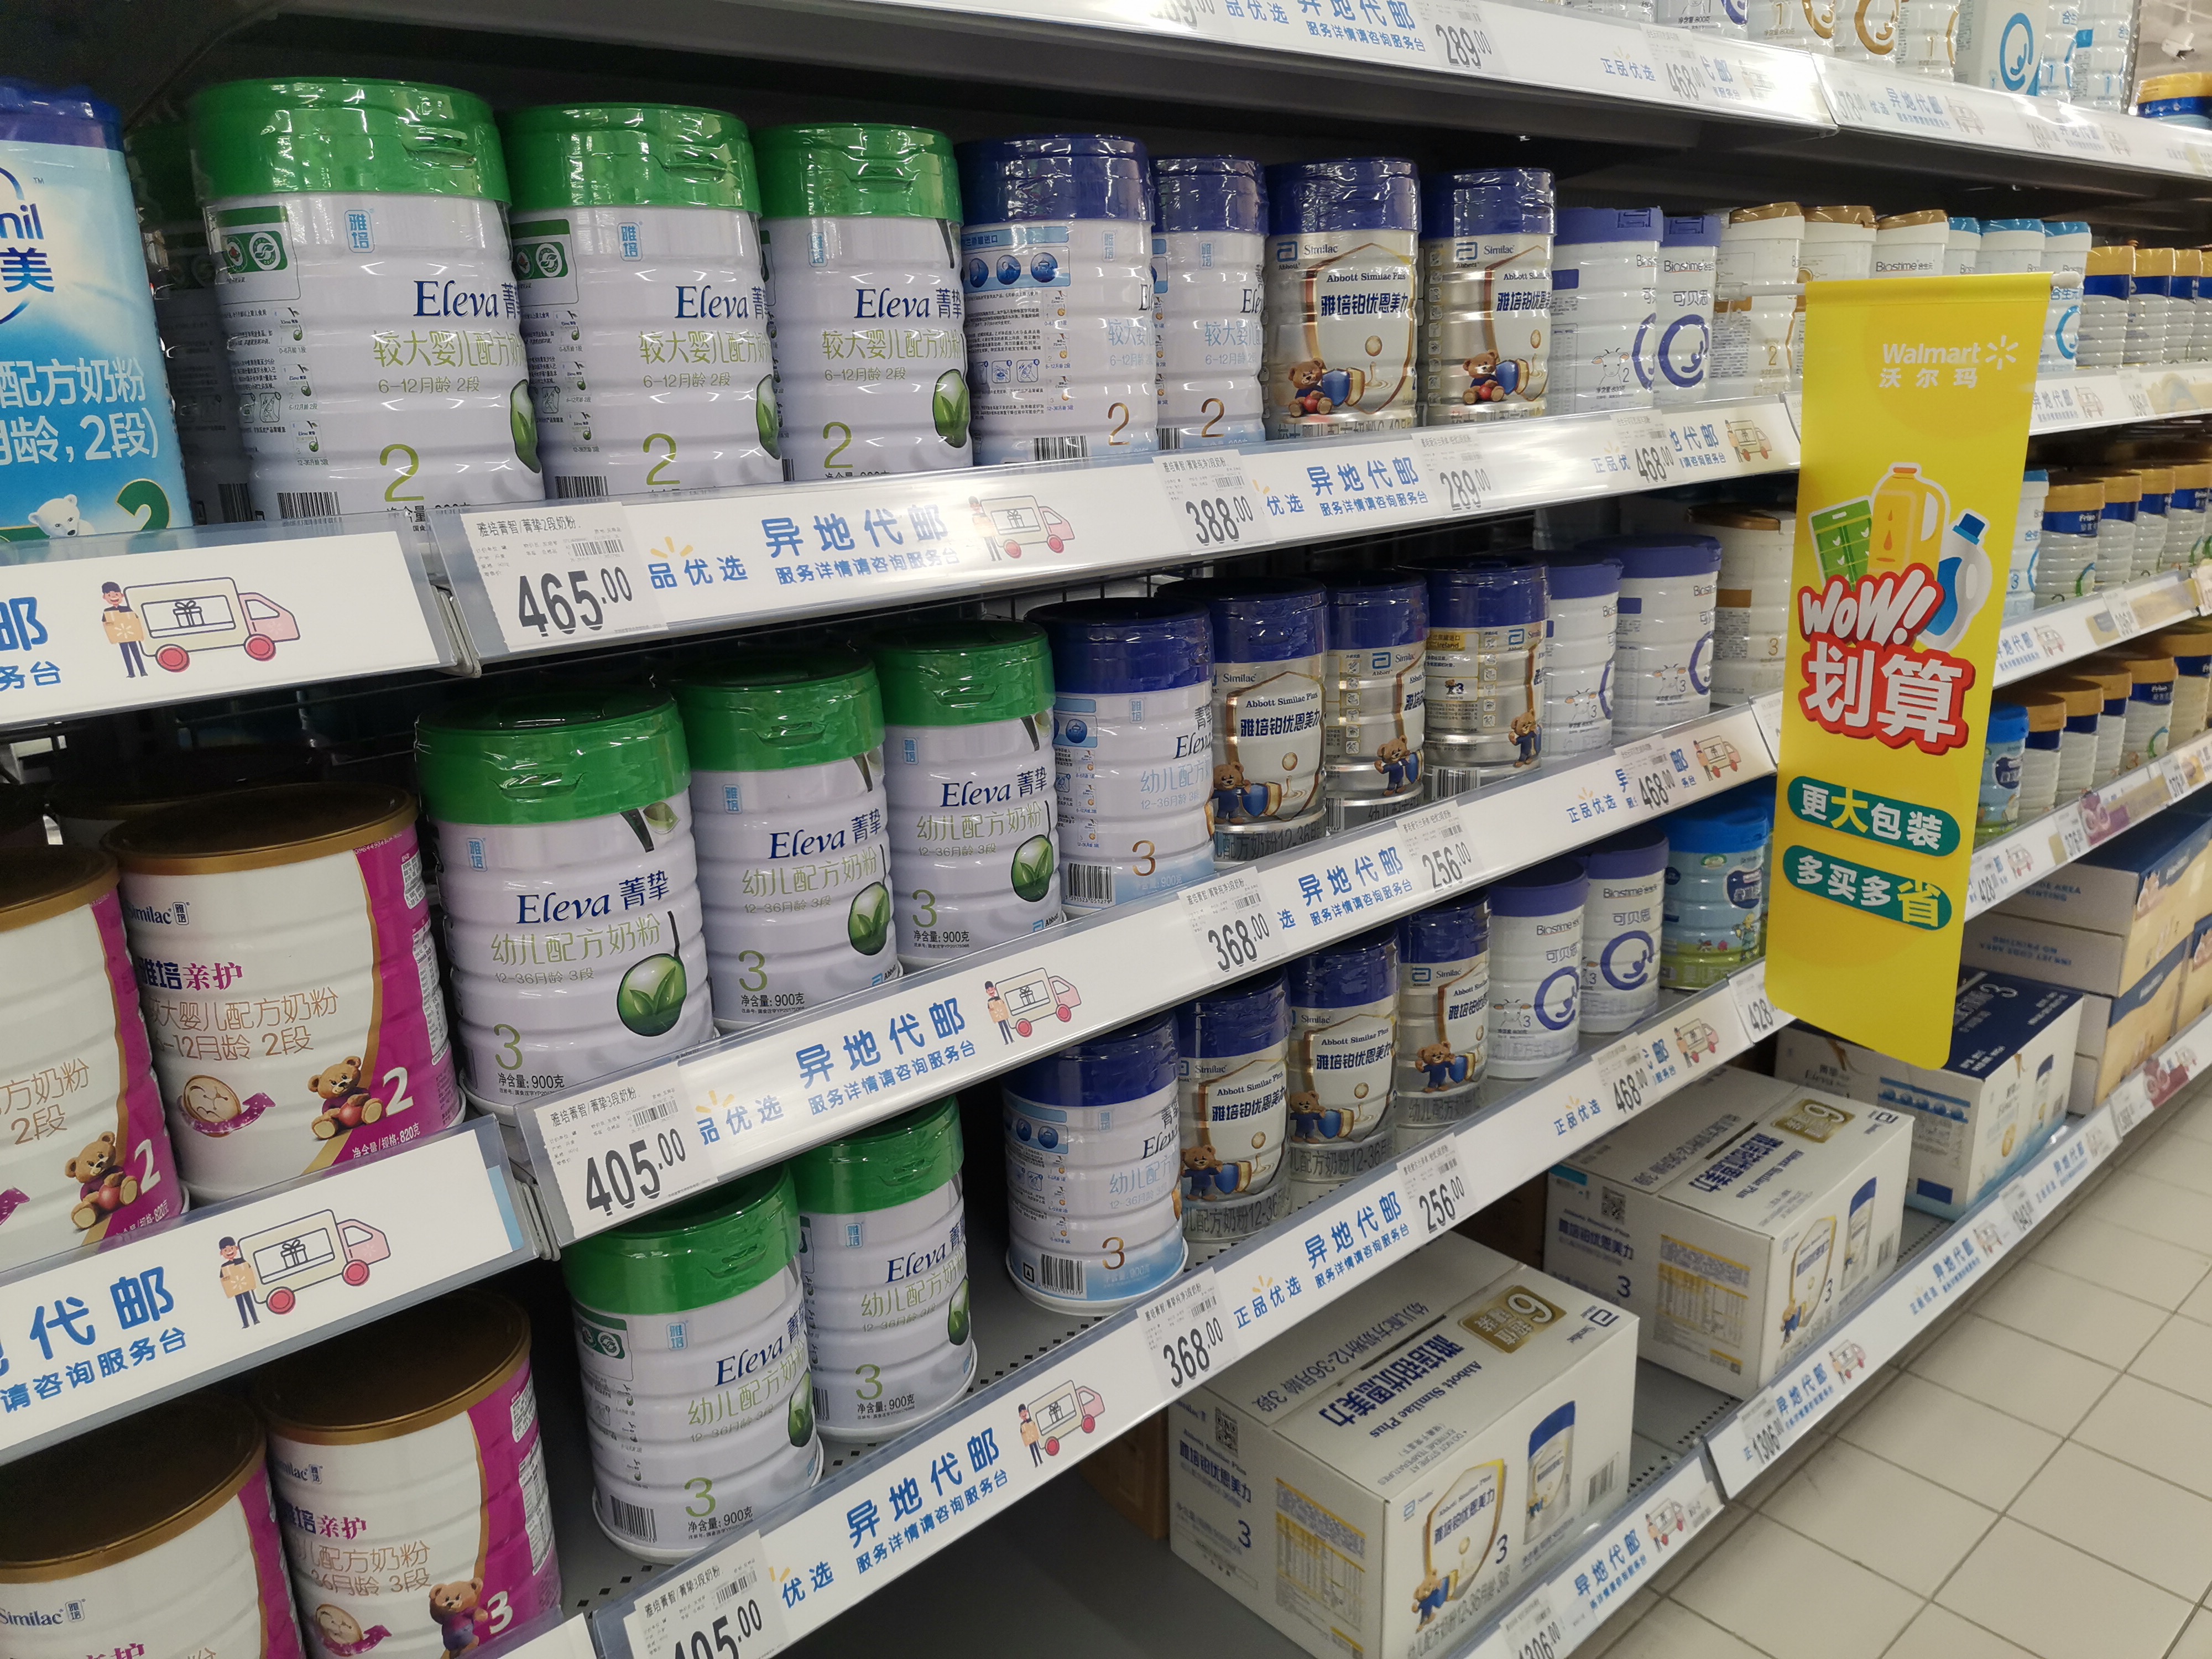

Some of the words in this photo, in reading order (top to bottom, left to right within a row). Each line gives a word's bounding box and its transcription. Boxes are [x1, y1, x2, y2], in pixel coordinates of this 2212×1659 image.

[1307, 19, 1427, 52] 服务详情请咨询服务台
[1436, 23, 1493, 69] 289.00
[1601, 57, 1656, 82] 正品优选
[1666, 62, 1704, 101] 468.00
[1885, 86, 1942, 115] 异地代邮
[348, 213, 371, 249] 雅培
[1303, 244, 1338, 255] Similac
[1483, 244, 1515, 255] Similac
[1664, 260, 1703, 273] Biostime
[1875, 261, 1917, 273] Biostime
[0, 247, 55, 293] 美
[1326, 273, 1359, 283] Abbott
[1360, 272, 1391, 282] Similac
[413, 279, 500, 319] Eleva
[674, 285, 750, 319] Eleva
[854, 288, 932, 320] Eleva
[936, 288, 963, 319] 菁挚
[1321, 291, 1408, 317] 雅培铂优恩美力
[822, 329, 962, 361] 较大婴儿配方奶粉
[1769, 345, 1778, 366] 2
[1882, 342, 1980, 364] Walmart
[378, 378, 451, 394] 6-12月龄
[457, 376, 481, 393] 2段
[643, 373, 706, 389] 6-12月龄
[711, 372, 731, 387] 2段
[825, 367, 880, 382] 6-12月龄
[886, 366, 906, 380] 2段
[1623, 367, 1630, 383] 2
[1879, 368, 1978, 388] 沃尔玛
[1107, 402, 1130, 446] 2
[1201, 397, 1225, 438] 2
[642, 432, 681, 486] 2
[822, 421, 854, 468] 2
[379, 444, 425, 502] 2
[1306, 456, 1420, 497] 异地代邮
[1635, 446, 1673, 483] 468.00
[1266, 494, 1305, 517] 优选
[1319, 490, 1428, 518] 服务详情请咨询服务台
[1440, 467, 1491, 512] 289.00
[761, 504, 950, 559] 异地代邮
[1186, 494, 1254, 547] 388.00
[648, 554, 749, 590] 品优选
[775, 547, 961, 586] 服务详情请咨询服务台
[2011, 574, 2020, 590] 3
[519, 566, 633, 637] 465.00
[1768, 638, 1778, 656] 3
[1222, 673, 1255, 683] Similac
[1679, 679, 1687, 692] 3
[1805, 641, 1963, 743] 划算
[1246, 699, 1276, 708] Abbott
[1277, 696, 1305, 707] Similac
[1590, 705, 1597, 718] 3
[1240, 710, 1321, 737] 雅培铂优恩美力
[904, 738, 916, 763] 雅培
[725, 786, 739, 812] 雅培
[940, 781, 1013, 808] Eleva
[1017, 766, 1048, 797] 菁挚
[1140, 795, 1187, 810] 12-36月龄
[1639, 768, 1676, 810] 468.00
[916, 800, 1042, 842] 幼儿配方奶粉
[1566, 795, 1617, 823] 正品优选
[1801, 783, 1943, 851] 更大包装
[766, 829, 846, 860] Eleva
[851, 808, 882, 844] 菁挚
[919, 844, 974, 858] 12-36月龄
[977, 843, 997, 855] 3段
[468, 840, 484, 869] 雅培
[742, 845, 878, 898] 幼儿配方奶粉
[1131, 840, 1156, 877] 3
[1422, 841, 1472, 894] 256.00
[1298, 846, 1404, 907] 异地代邮
[1603, 887, 1643, 899] Biostime
[1797, 855, 1940, 928] 多买多省
[516, 891, 611, 925] Eleva
[618, 869, 670, 911] 菁挚
[744, 899, 807, 914] 12-36月龄
[811, 895, 832, 909] 3段
[911, 889, 938, 928] 3
[1309, 879, 1413, 927] 服务详情请咨询服务台
[1279, 909, 1297, 931] 选
[1536, 921, 1572, 936] Biostime
[491, 912, 661, 966] 幼儿配方奶粉
[1208, 912, 1270, 973] 368.00
[494, 972, 563, 985] 12-36月龄
[570, 968, 594, 982] 3段
[738, 950, 769, 992] 3
[1436, 968, 1461, 979] Similac
[1589, 972, 1597, 985] 3
[1453, 984, 1474, 997] Abbott
[1301, 1014, 1331, 1024] Similac
[1522, 1015, 1531, 1028] 3
[261, 1025, 314, 1057] 2段
[493, 1024, 524, 1071] 3
[796, 997, 966, 1089] 异地代邮
[1316, 1042, 1392, 1071] 雅培铂优恩美力
[1321, 1037, 1349, 1047] Abbott
[1350, 1032, 1376, 1044] Similac
[807, 1040, 976, 1117] 服务详情请咨询服务台
[1194, 1064, 1225, 1074] Similac
[382, 1067, 414, 1118] 2
[1211, 1084, 1287, 1123] 雅培铂优恩美力
[1217, 1086, 1245, 1097] Abbott
[1246, 1079, 1272, 1093] Similac
[1613, 1068, 1648, 1115] 468.00
[11, 1104, 67, 1146] 2段
[697, 1095, 784, 1146] 品优选
[1554, 1098, 1602, 1137] 正品优选
[134, 1138, 162, 1195] 2
[586, 1128, 686, 1217] 405.00
[1418, 1176, 1465, 1235] 256.00
[1305, 1191, 1402, 1270] 异地代邮
[885, 1242, 946, 1284] Eleva
[1102, 1237, 1126, 1271] 3
[1314, 1223, 1411, 1290] 服务详情请咨询服务台
[1233, 1275, 1303, 1329] 正品优选
[1616, 1274, 1631, 1298] 3
[1506, 1292, 1554, 1326] 6
[0, 1327, 187, 1413] 请咨询服务台
[714, 1335, 784, 1387] Eleva
[1162, 1317, 1224, 1389] 368.00
[855, 1364, 883, 1400] 3
[1318, 1333, 1465, 1427] 雅培铂优恩美力
[1446, 1360, 1483, 1391] Abbott
[1776, 1362, 1828, 1415] 异地代邮
[1398, 1385, 1447, 1420] Similac
[1369, 1415, 1401, 1439] Plus
[685, 1477, 717, 1517] 3
[846, 1427, 999, 1548] 异地代邮
[855, 1468, 1011, 1575] 服务详情请咨询服务台
[1237, 1519, 1251, 1549] 3
[1495, 1533, 1509, 1565] 3
[1574, 1529, 1641, 1595] 异地代邮
[389, 1567, 432, 1593] 3段
[781, 1560, 834, 1609] 优选
[487, 1592, 514, 1635] 3
